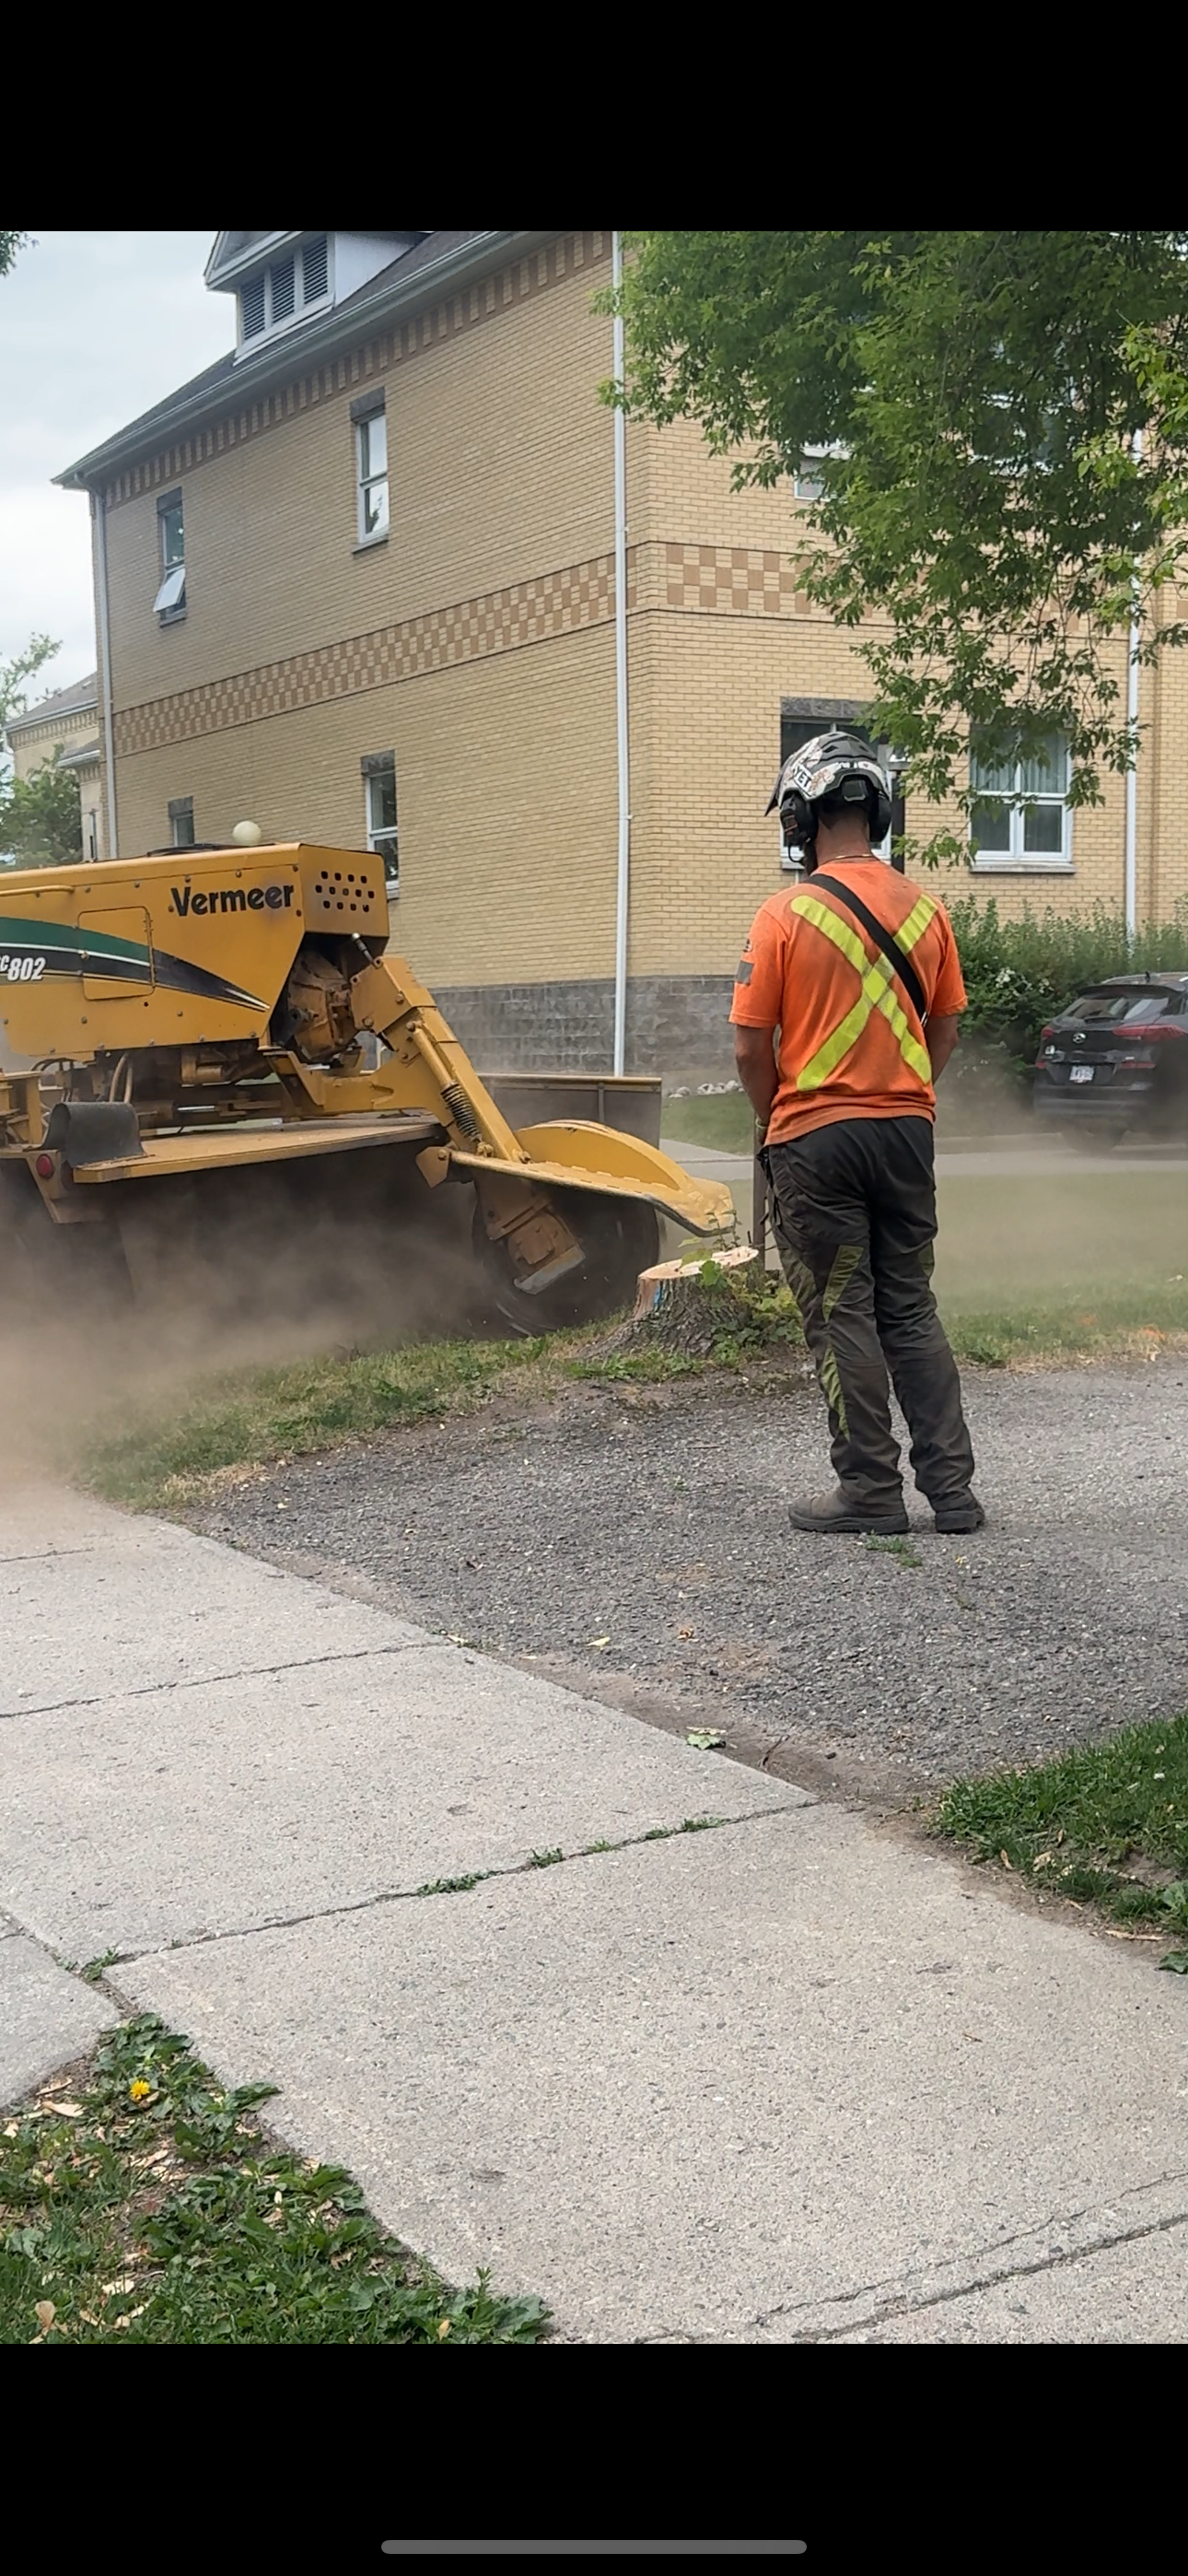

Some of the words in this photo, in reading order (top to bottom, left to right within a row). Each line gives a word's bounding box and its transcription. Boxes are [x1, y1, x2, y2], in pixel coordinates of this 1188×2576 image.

[795, 766, 812, 790] YET
[170, 884, 294, 917] Vermeer
[0, 954, 47, 981] C802
